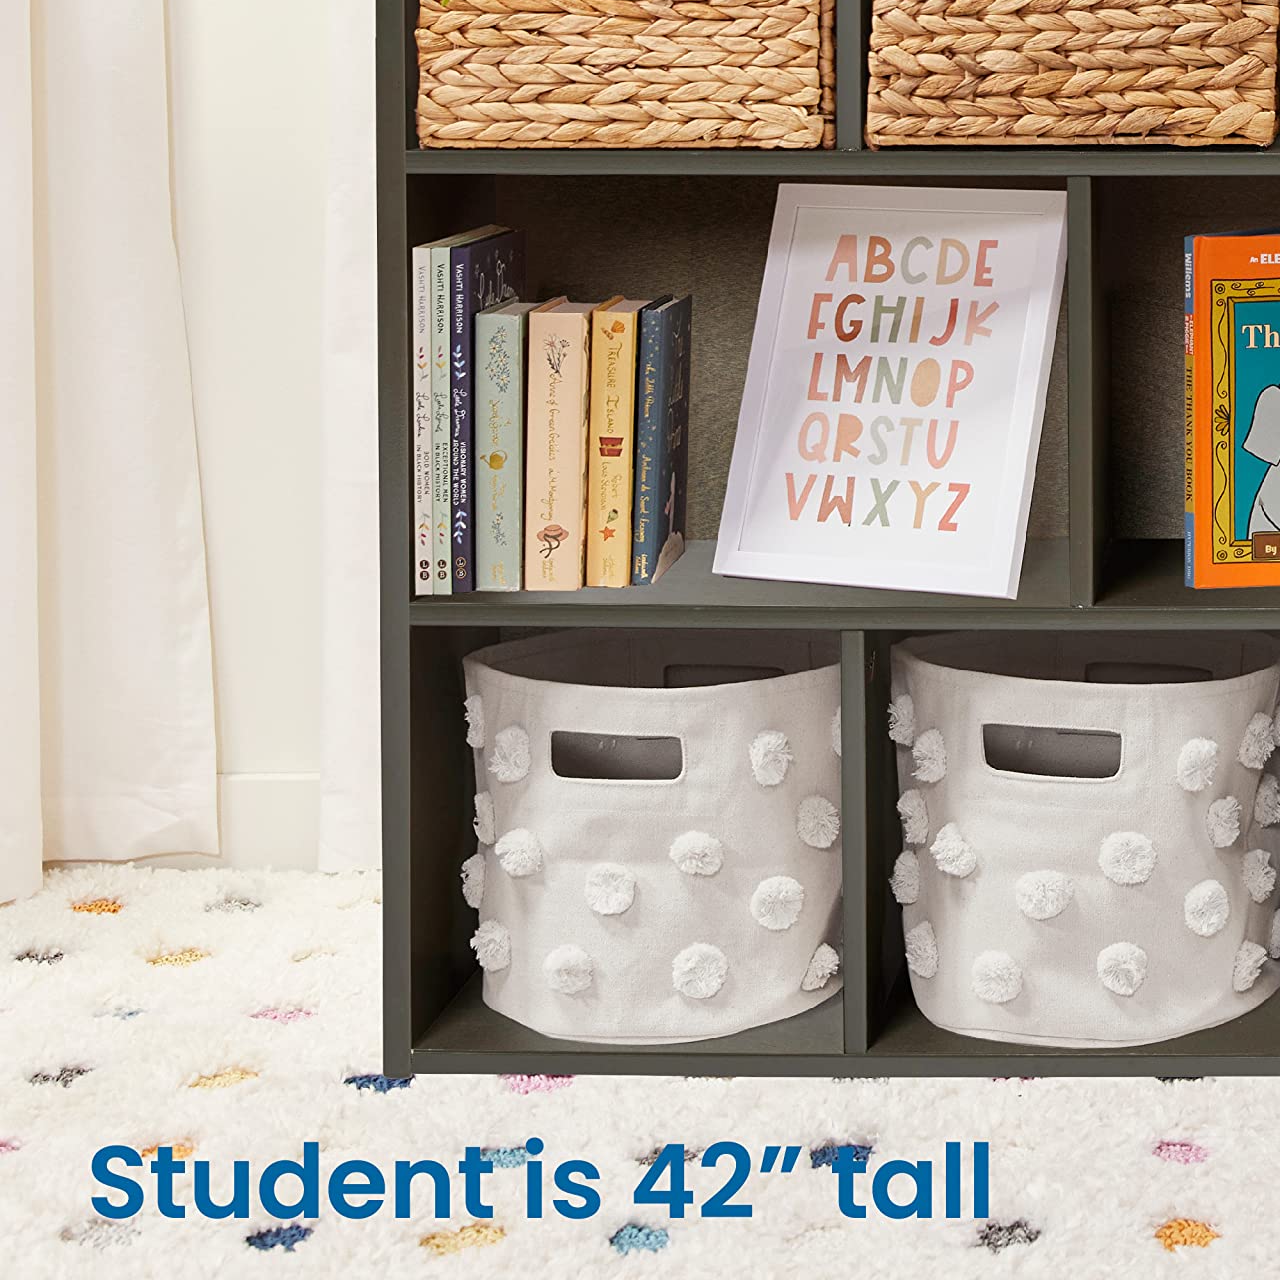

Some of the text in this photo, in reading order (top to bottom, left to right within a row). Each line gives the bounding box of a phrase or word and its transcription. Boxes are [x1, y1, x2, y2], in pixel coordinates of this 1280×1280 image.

[418, 266, 426, 333] VASHTI HARRISON
[436, 264, 445, 333] VASHTI HARRISON
[455, 264, 464, 333] VASHTI HARRISON
[1265, 545, 1277, 555] By
